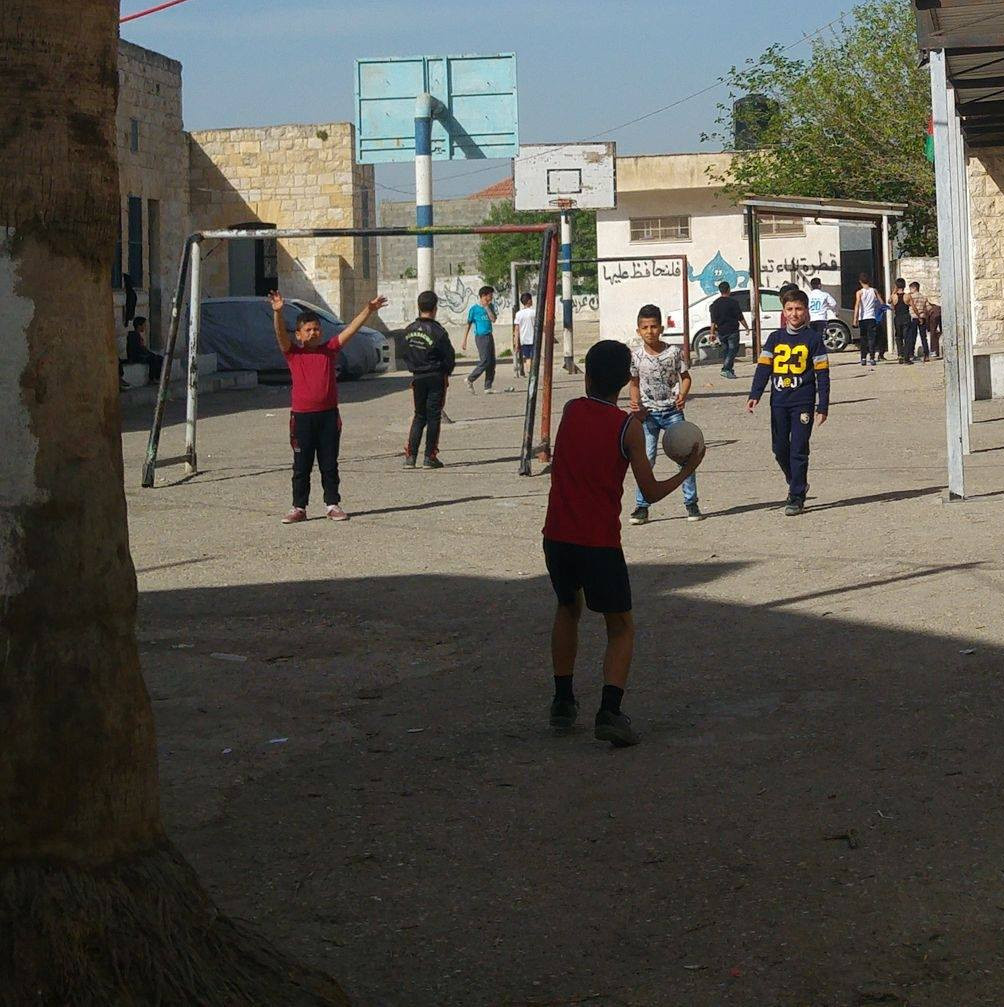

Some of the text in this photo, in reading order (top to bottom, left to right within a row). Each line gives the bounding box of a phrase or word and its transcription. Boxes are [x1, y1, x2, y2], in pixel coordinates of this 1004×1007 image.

[602, 262, 629, 285] عليها
[800, 250, 838, 277] قطرة
[772, 343, 809, 375] 23
